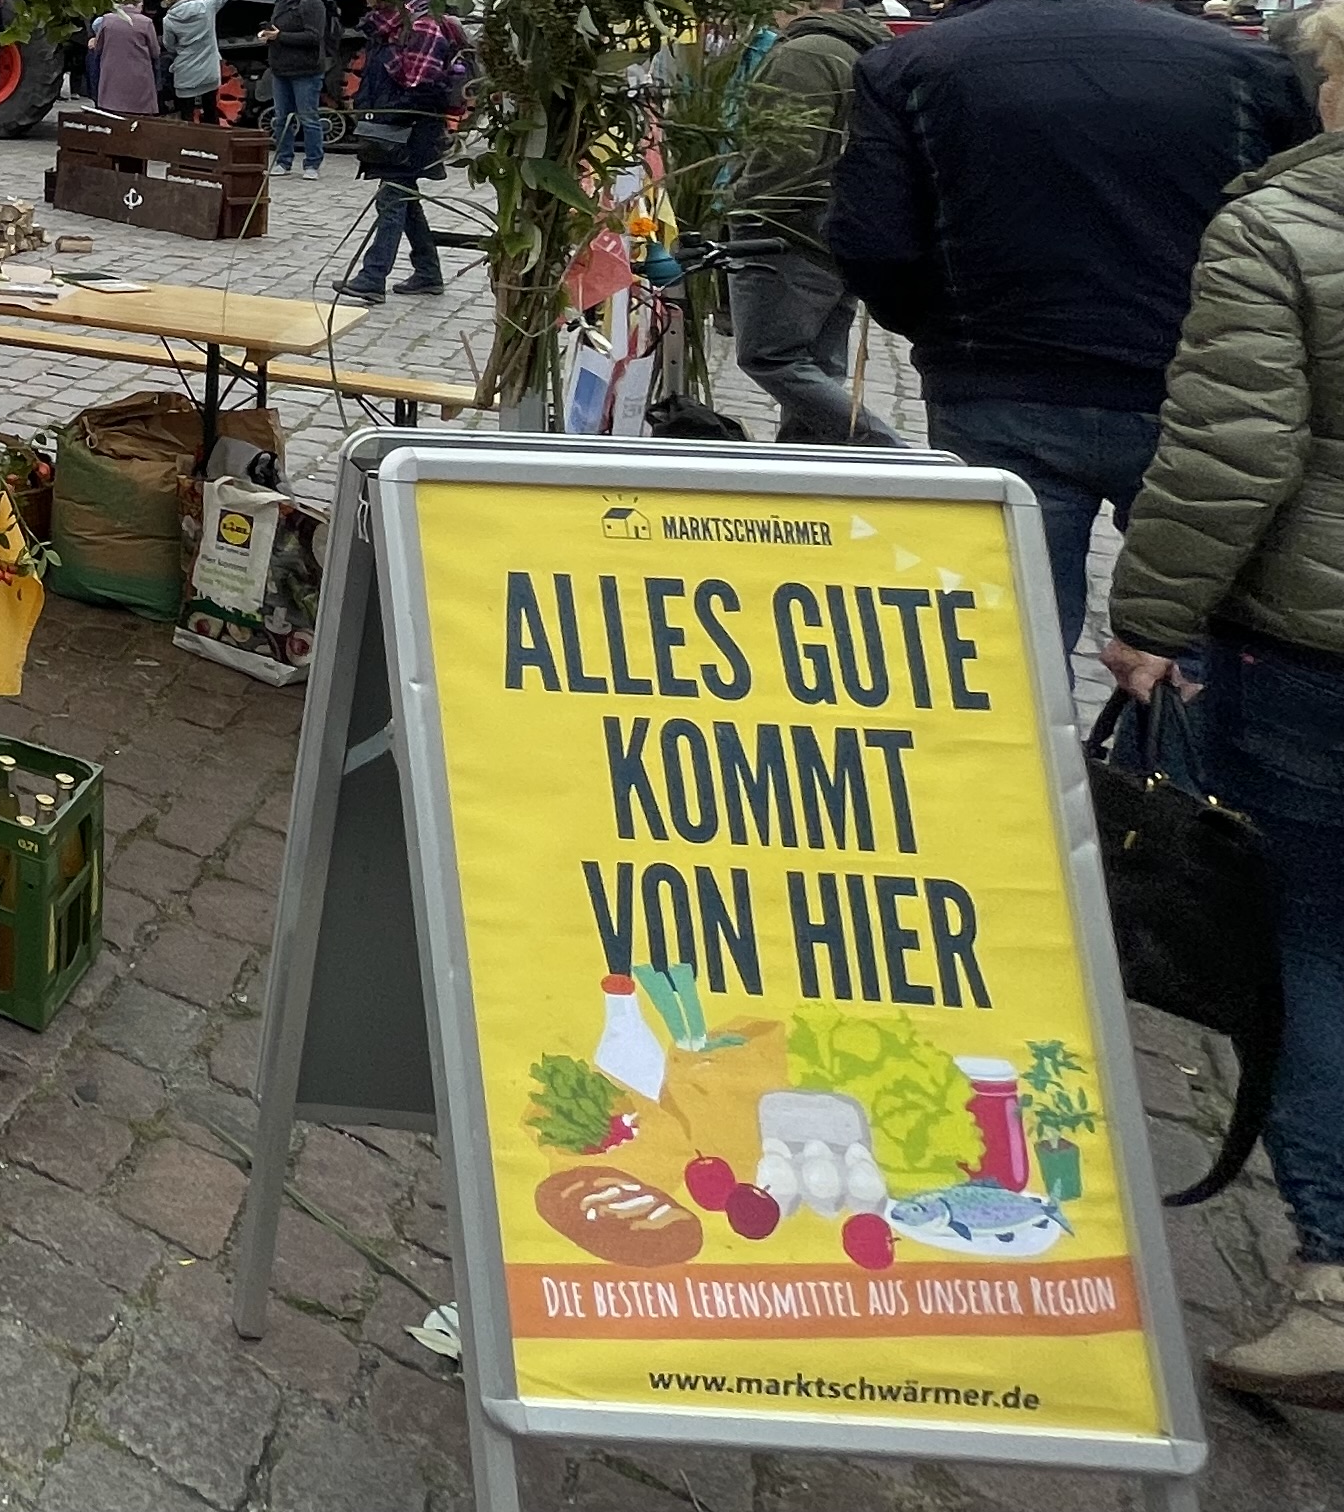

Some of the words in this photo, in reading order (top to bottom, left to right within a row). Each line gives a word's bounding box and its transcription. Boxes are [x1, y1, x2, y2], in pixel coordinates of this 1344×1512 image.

[661, 515, 833, 546] MARKTSCHWÄRMER
[505, 571, 752, 700] ALLES
[773, 582, 991, 710] GUTE
[603, 716, 918, 854] KOMMT
[581, 860, 763, 996] VON
[786, 871, 993, 1009] HIER
[649, 1372, 1041, 1410] www.marktschwärmer.de
